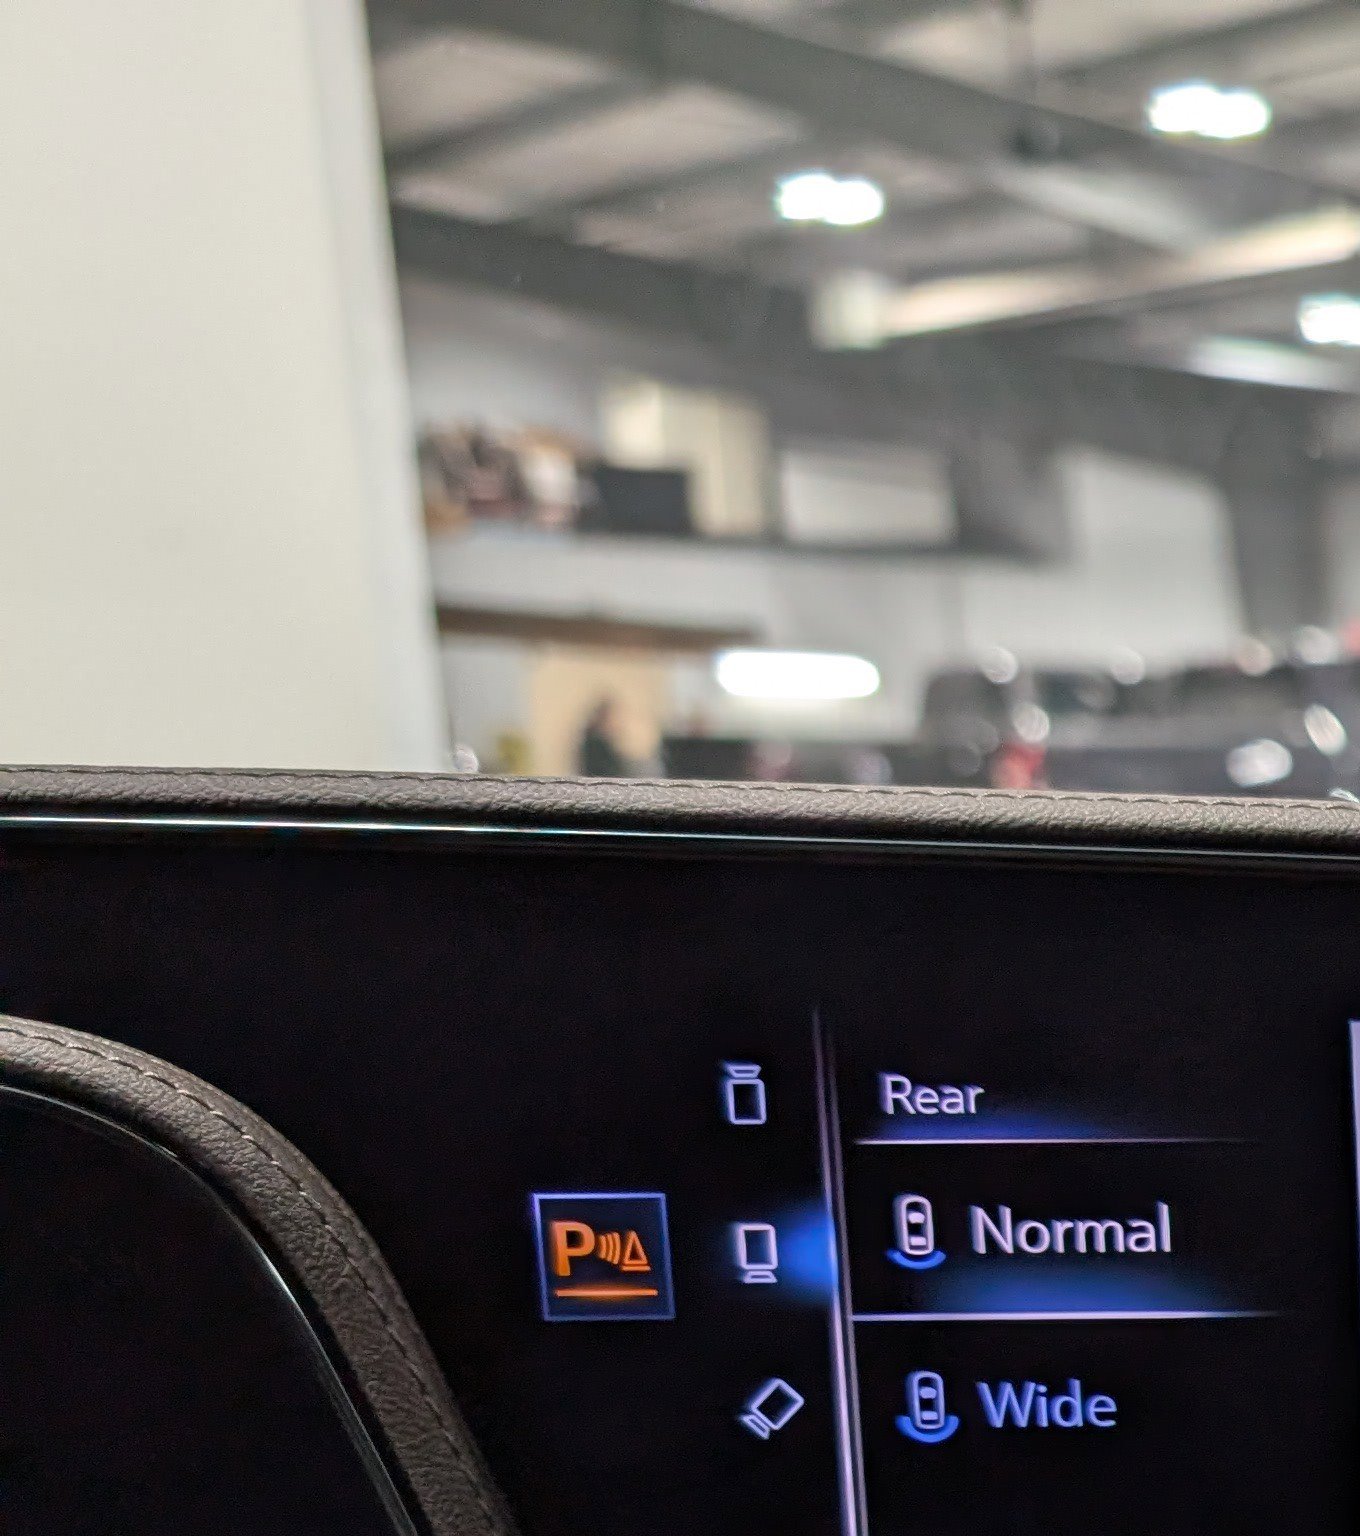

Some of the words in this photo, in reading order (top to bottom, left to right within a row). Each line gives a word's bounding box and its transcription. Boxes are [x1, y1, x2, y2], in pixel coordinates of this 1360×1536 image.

[880, 1073, 985, 1115] Rear
[971, 1202, 1171, 1254] Normal
[977, 1379, 1118, 1428] Wide
